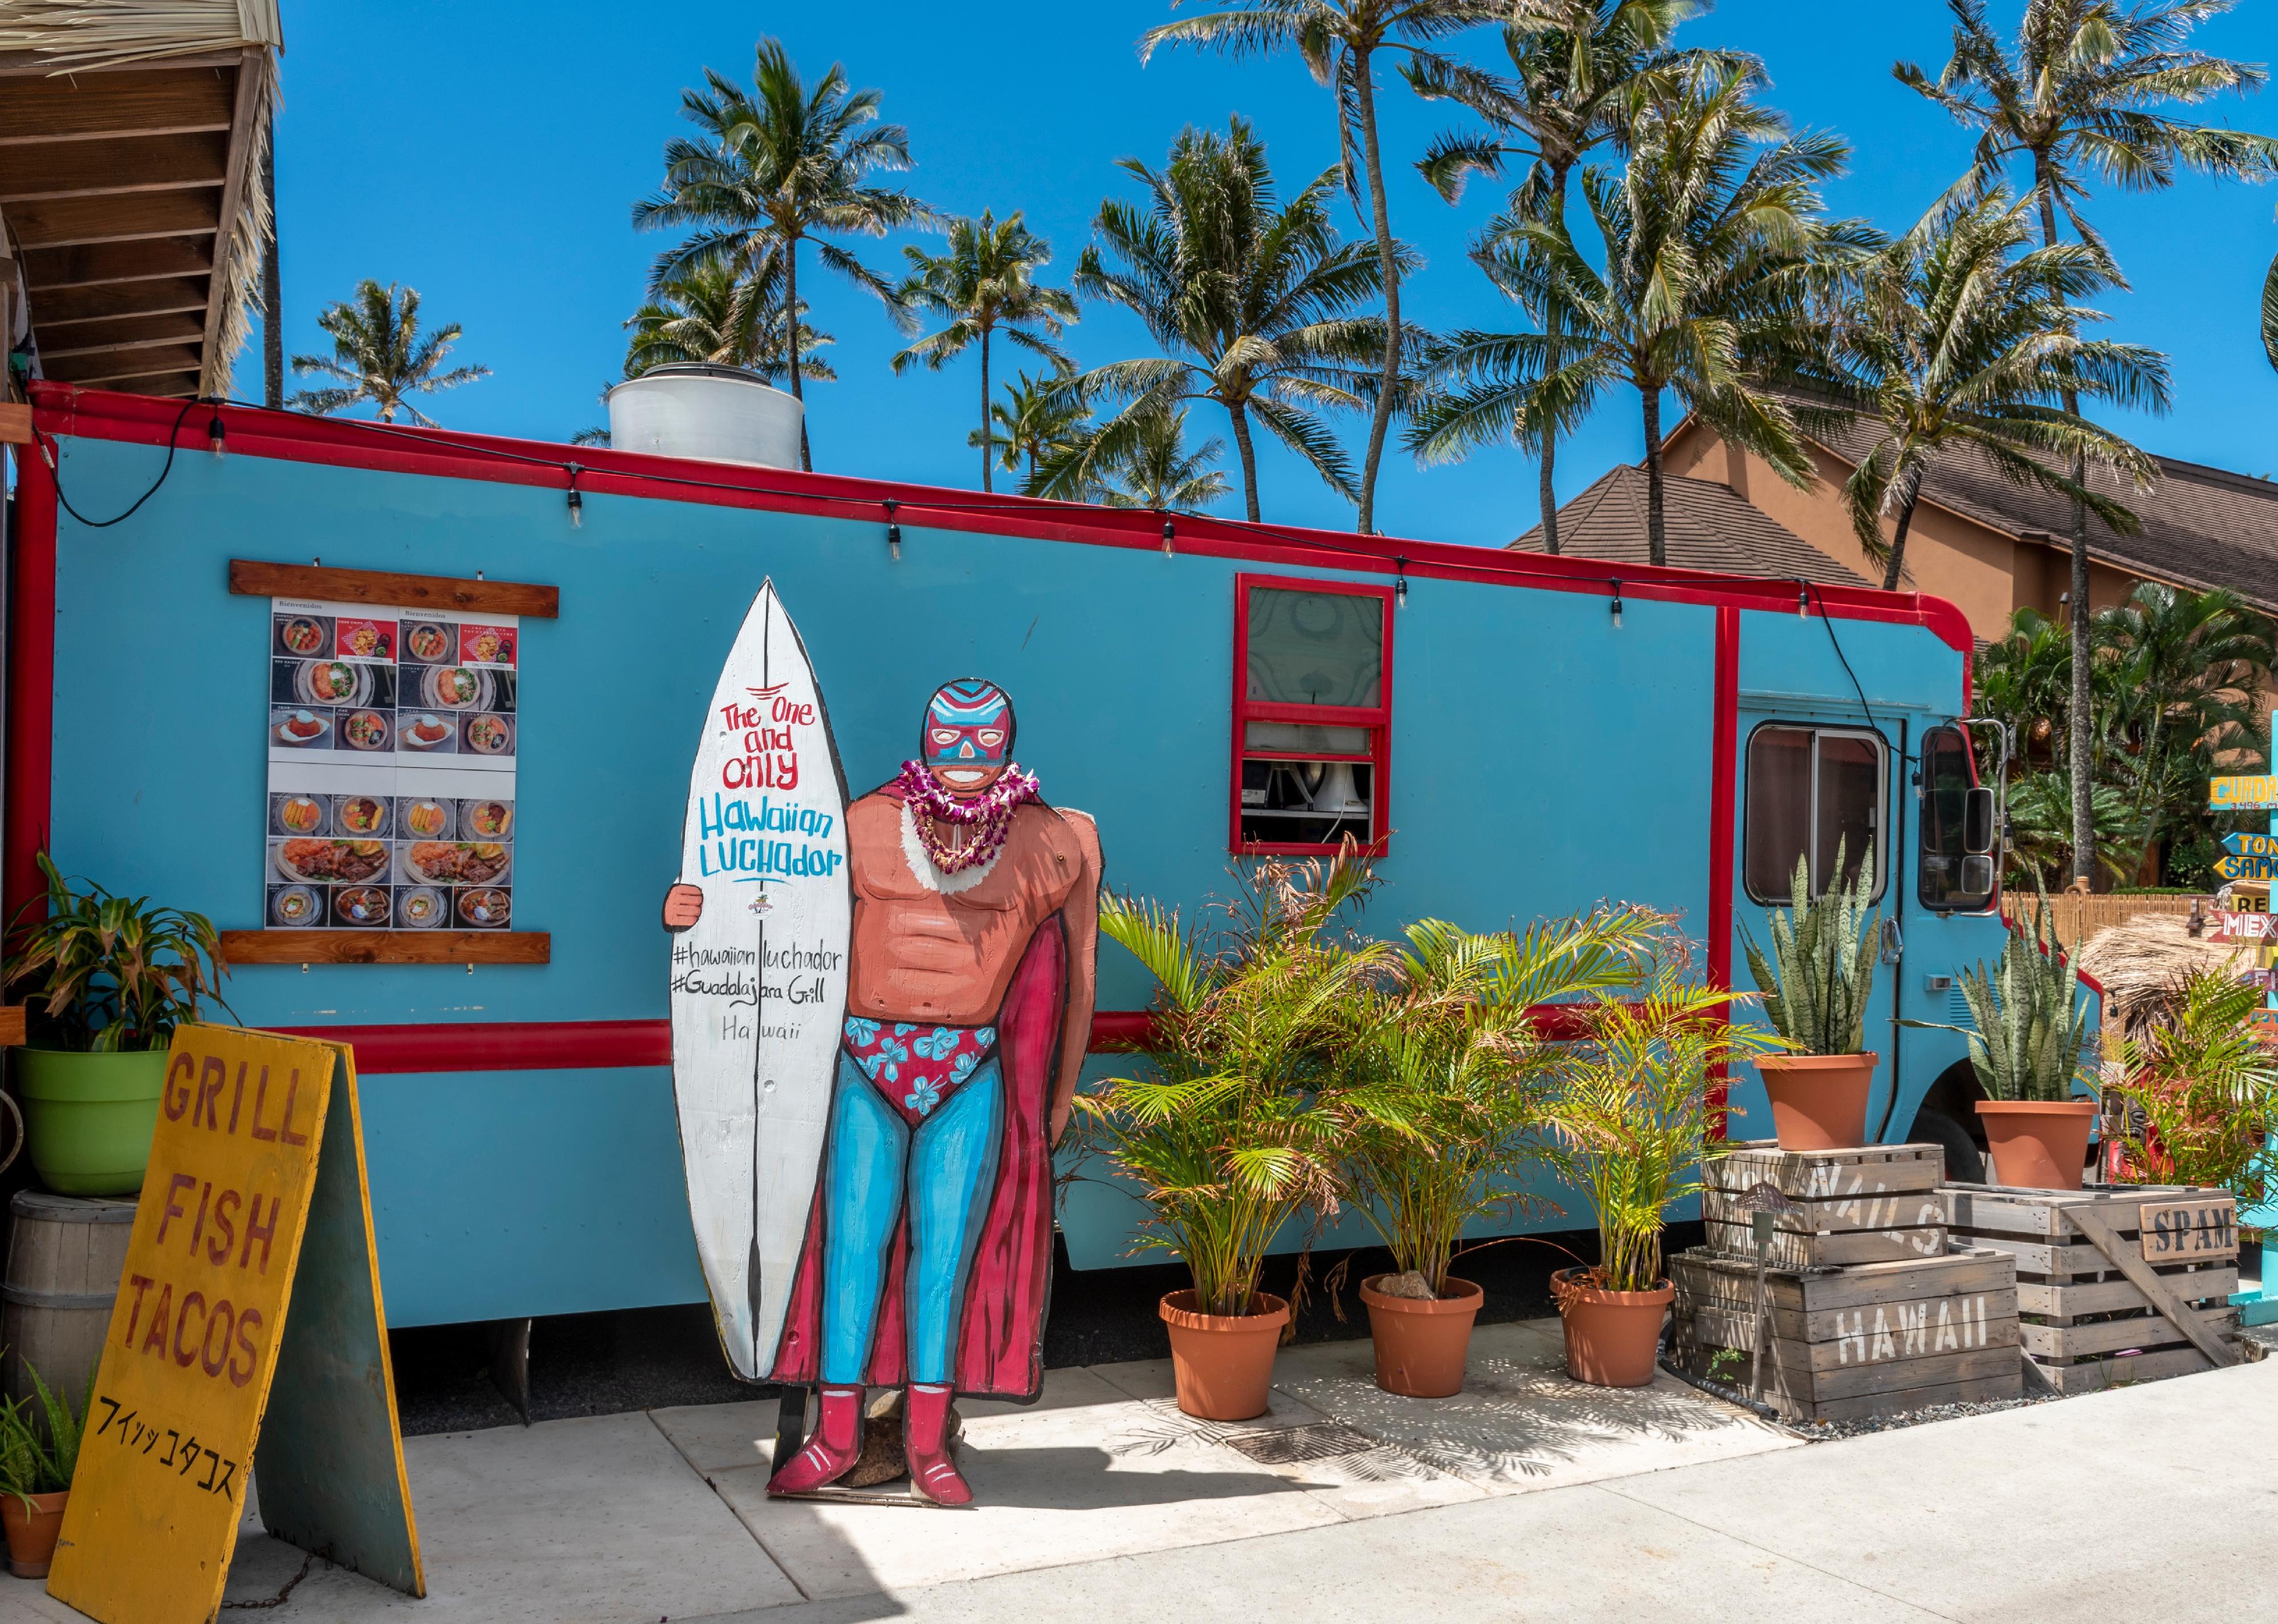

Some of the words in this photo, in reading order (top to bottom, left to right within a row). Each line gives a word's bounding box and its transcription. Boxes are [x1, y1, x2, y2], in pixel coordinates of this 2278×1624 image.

[720, 703, 761, 731] The
[772, 697, 815, 725] One
[744, 725, 793, 753] and
[788, 975, 825, 1004] Grill
[165, 1052, 308, 1147] GRILL
[157, 1173, 281, 1275] FISH
[2154, 1208, 2233, 1252] SPAM
[125, 1274, 263, 1389] TACOS
[1836, 1296, 1986, 1364] HAWAII
